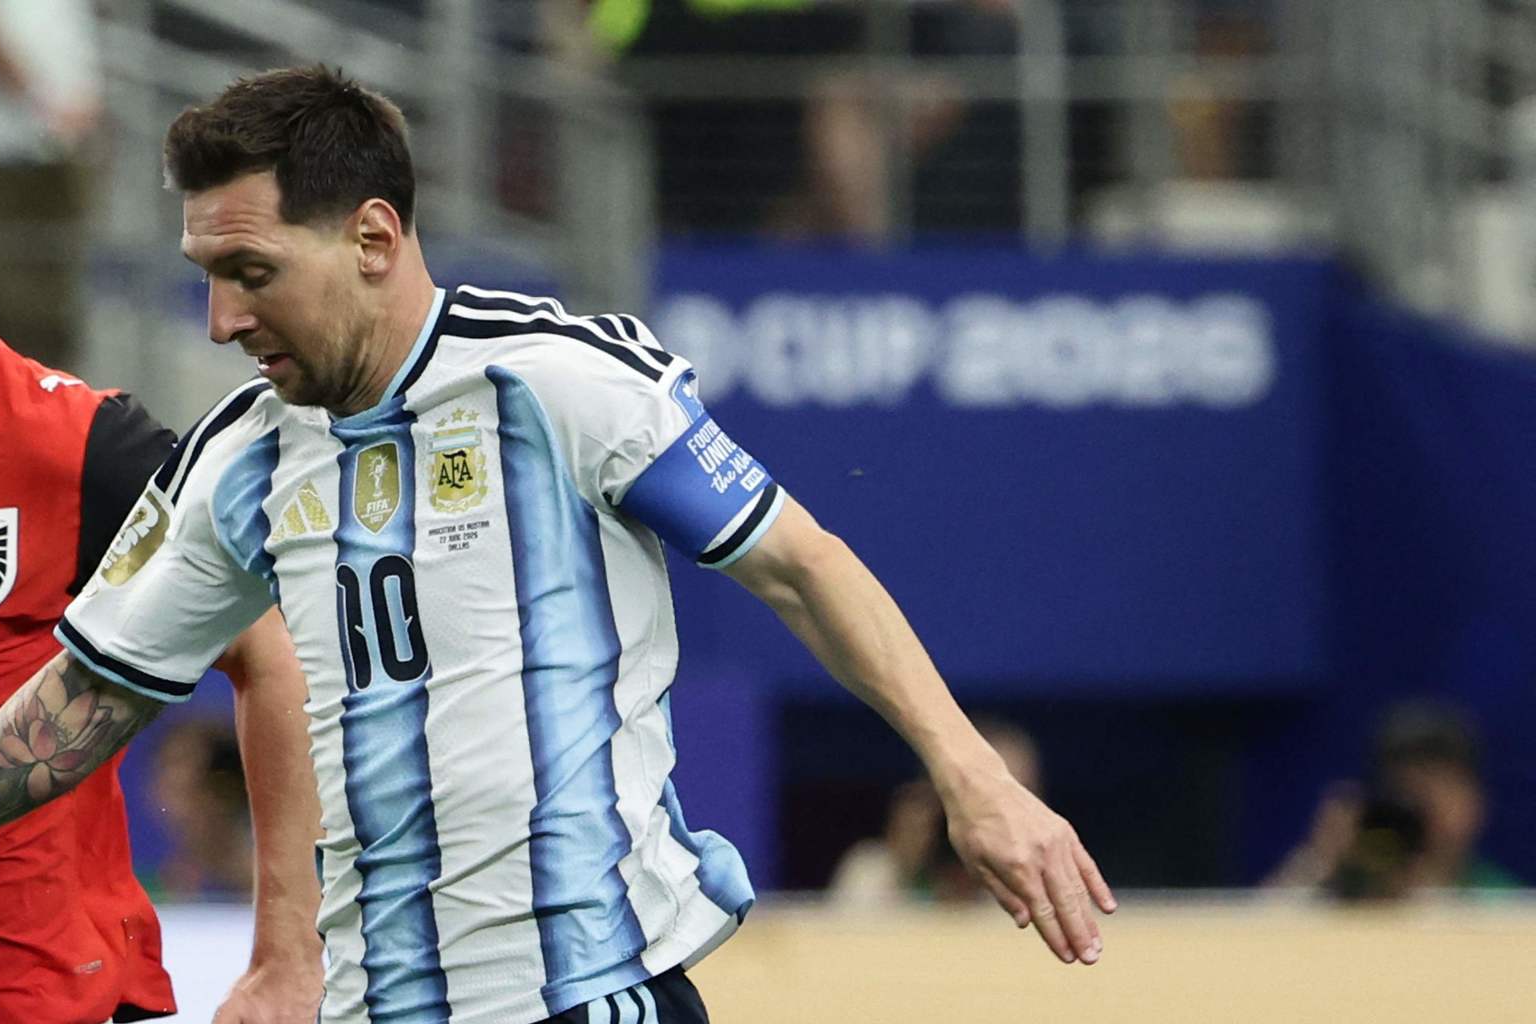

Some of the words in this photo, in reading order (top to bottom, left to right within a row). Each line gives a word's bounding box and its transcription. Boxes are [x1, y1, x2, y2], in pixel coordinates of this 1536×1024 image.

[750, 296, 926, 402] CUP
[944, 296, 1272, 402] 2026
[438, 450, 473, 489] AFA
[710, 468, 737, 494] the
[366, 500, 389, 513] FIFA
[336, 554, 430, 691] 10
